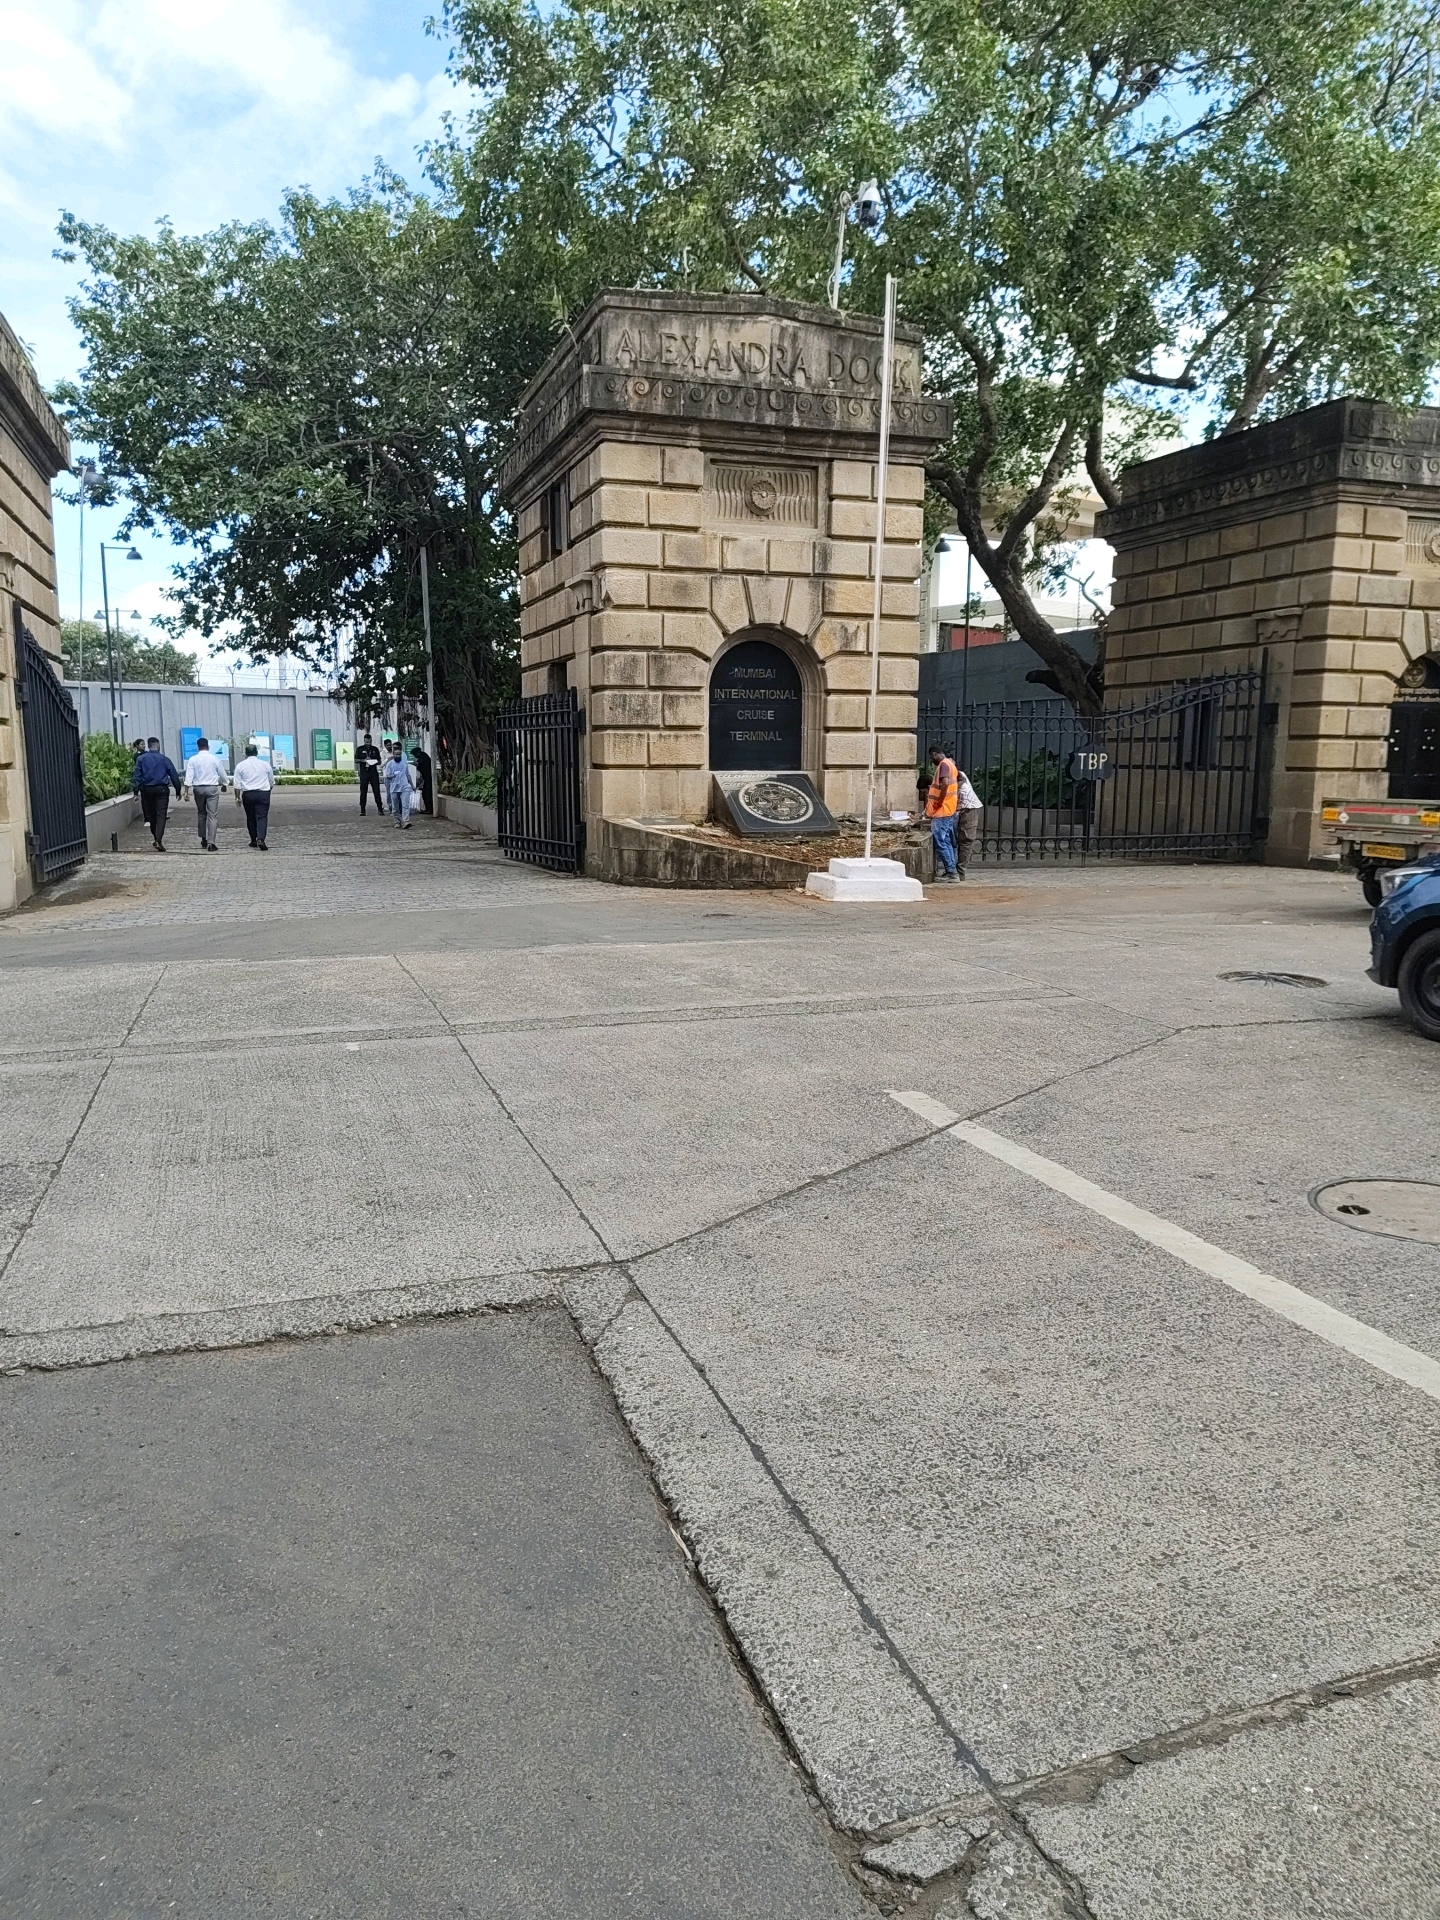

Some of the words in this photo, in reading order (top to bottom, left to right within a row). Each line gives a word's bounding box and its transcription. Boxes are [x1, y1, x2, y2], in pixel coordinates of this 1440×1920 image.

[616, 329, 812, 380] ALEXANDRA
[733, 668, 776, 679] MUMBAI
[714, 688, 797, 700] INTERNATIONAL
[737, 710, 774, 720] CRUISE
[730, 731, 782, 741] TERMINAL
[1077, 752, 1108, 770] TBP
